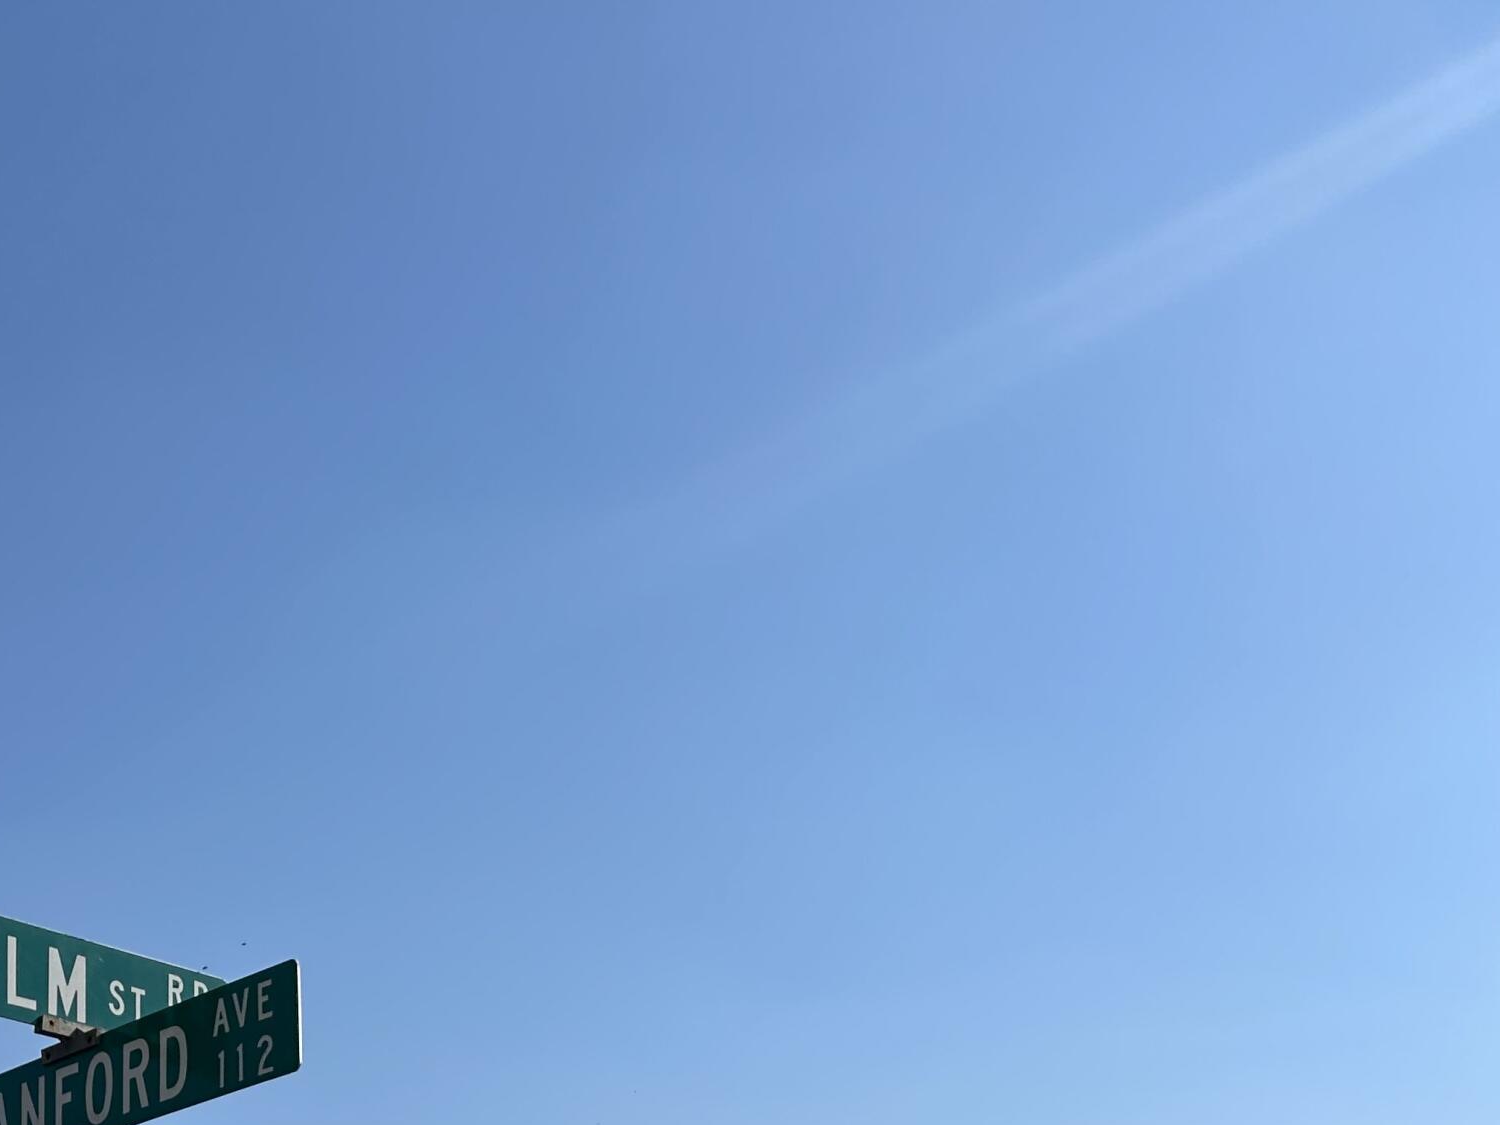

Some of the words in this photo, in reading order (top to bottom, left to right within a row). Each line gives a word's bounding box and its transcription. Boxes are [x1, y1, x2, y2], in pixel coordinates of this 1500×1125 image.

[108, 980, 146, 1019] ST
[212, 979, 273, 1037] AVE
[217, 1035, 274, 1089] 112
